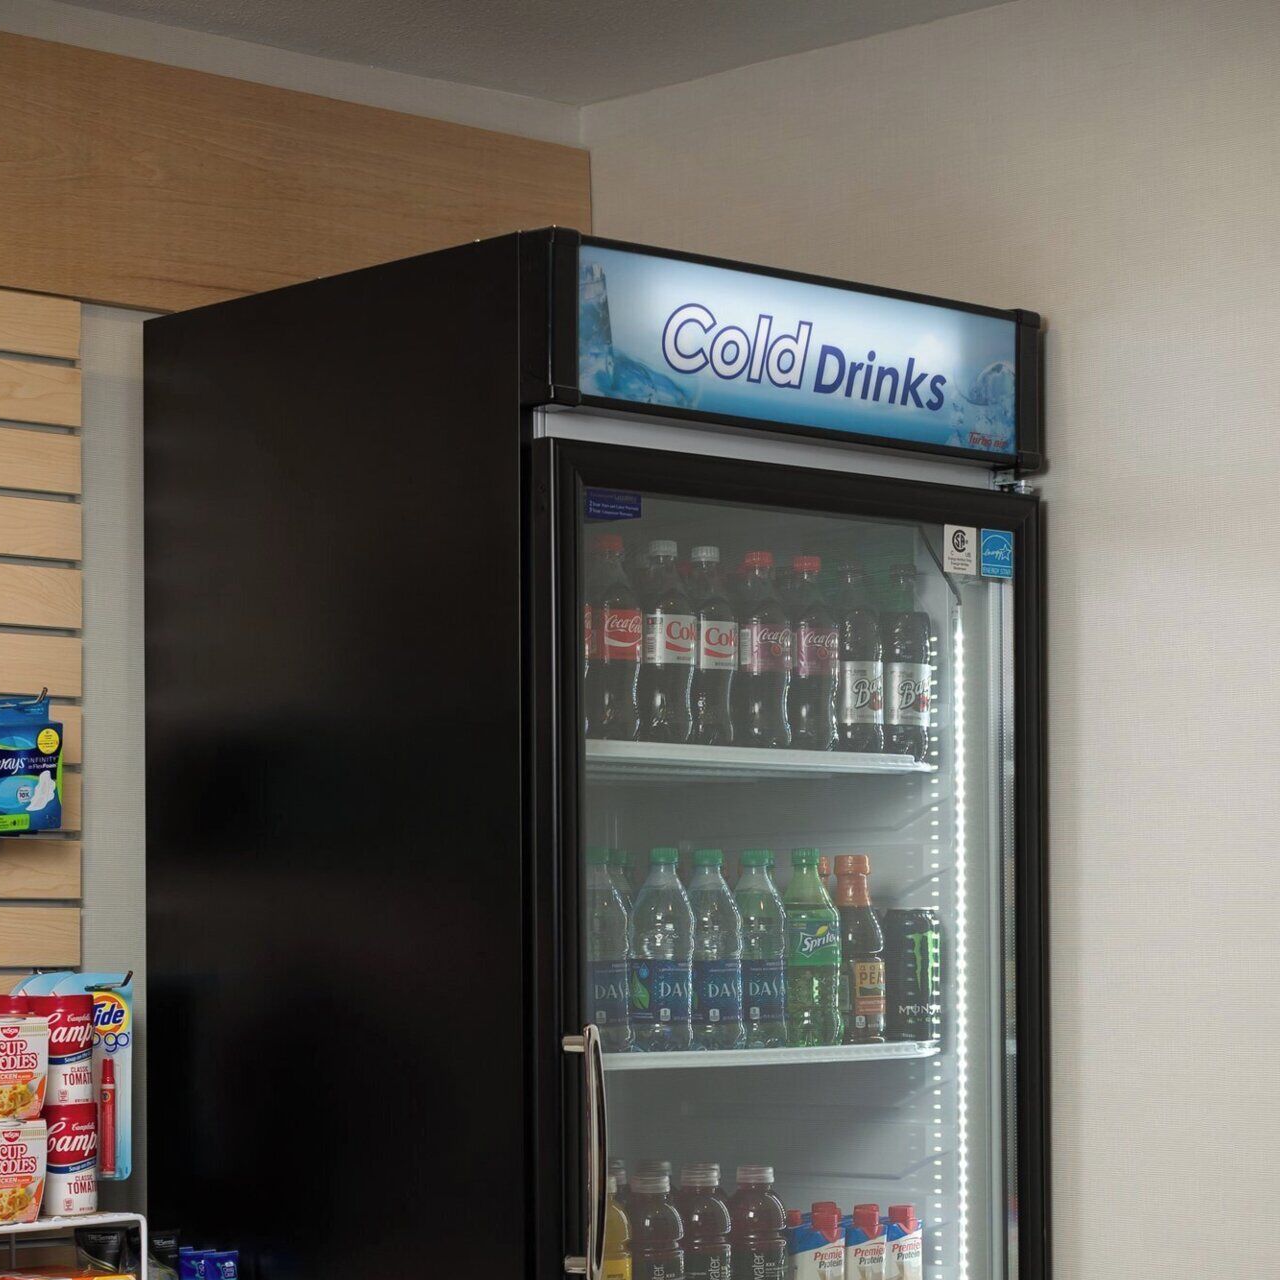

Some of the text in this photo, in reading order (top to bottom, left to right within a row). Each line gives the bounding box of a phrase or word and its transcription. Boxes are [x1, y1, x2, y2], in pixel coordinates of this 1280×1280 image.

[662, 303, 947, 411] Cold Drinks
[969, 431, 992, 447] Turbo
[802, 933, 838, 952] Sprite
[104, 1032, 129, 1052] go
[75, 1174, 93, 1182] CLASSIC
[859, 1256, 883, 1265] Protein
[897, 1251, 920, 1261] Protein
[819, 1259, 842, 1269] Protein
